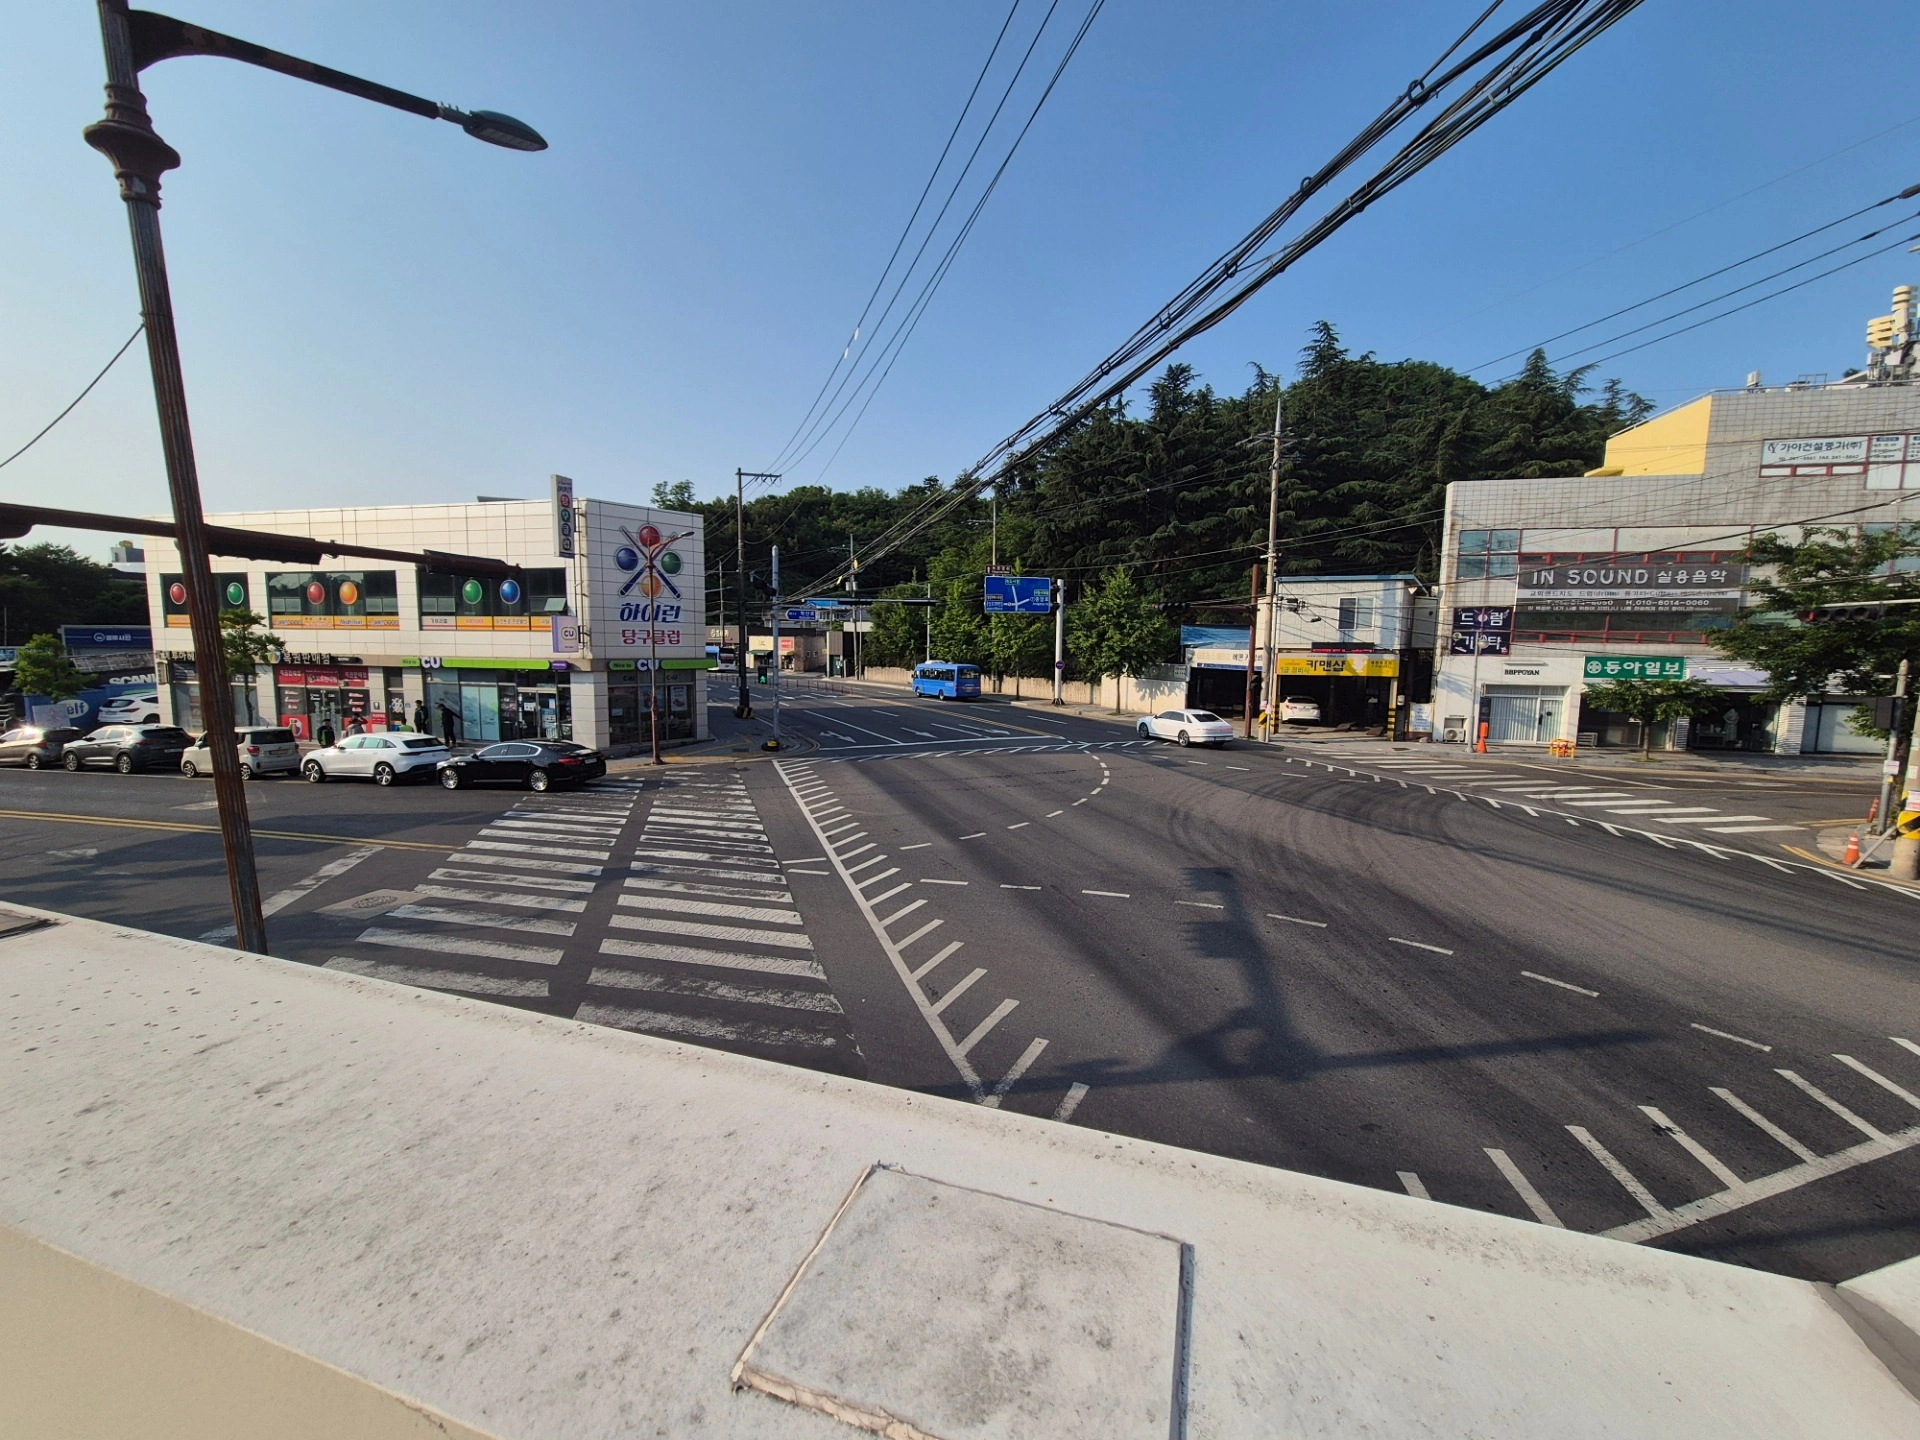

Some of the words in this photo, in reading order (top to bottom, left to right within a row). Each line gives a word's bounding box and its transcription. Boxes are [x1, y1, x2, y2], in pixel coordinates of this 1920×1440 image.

[1780, 441, 1863, 453] 가야건설중기(주)
[1532, 569, 1555, 585] IN
[1566, 568, 1649, 585] SOUND
[1657, 569, 1728, 585] 실용음악
[619, 602, 682, 624] 하이런
[1459, 611, 1504, 626] 드럼
[563, 628, 575, 638] CU
[621, 629, 681, 645] 당구클럽
[283, 652, 331, 665] 복권판매점
[420, 656, 441, 669] CU
[637, 659, 660, 671] CU
[1305, 659, 1347, 672] 카맨샵
[1603, 661, 1682, 676] 동아일보
[67, 701, 85, 715] elf
